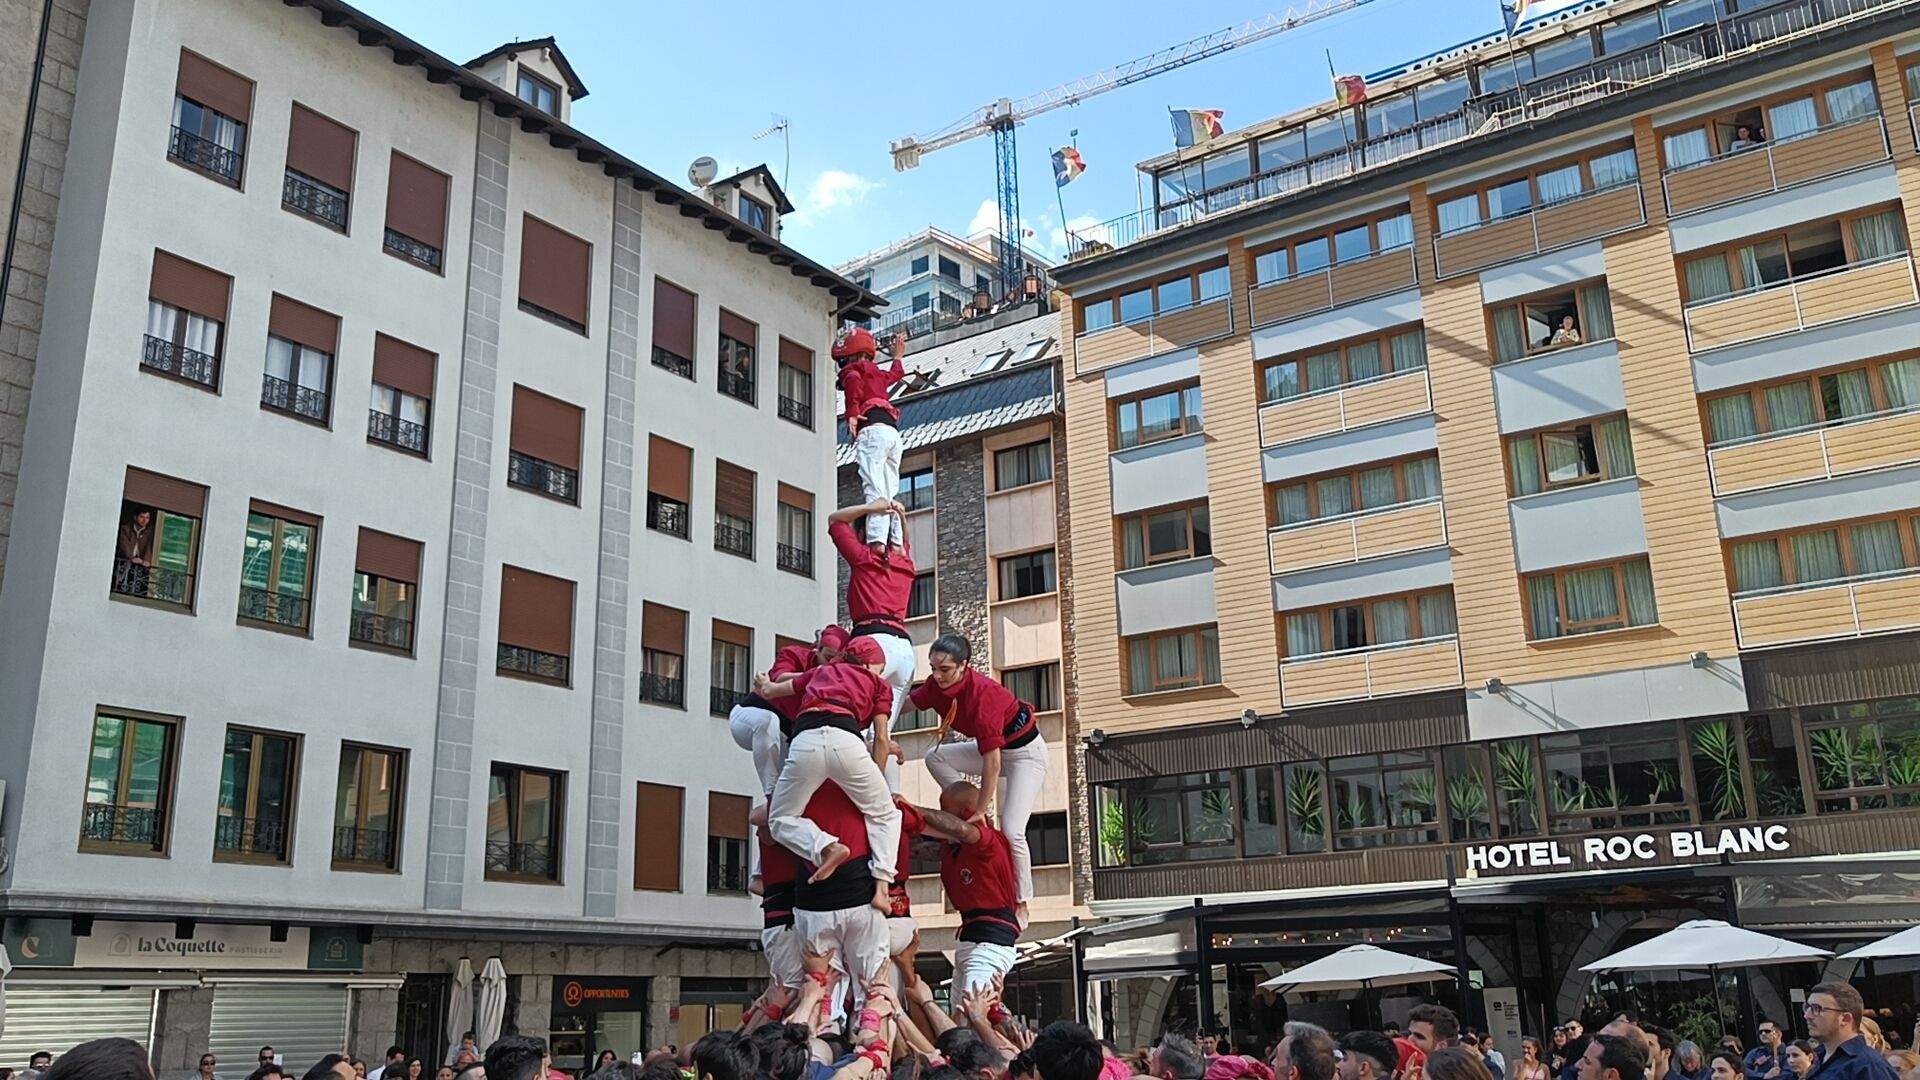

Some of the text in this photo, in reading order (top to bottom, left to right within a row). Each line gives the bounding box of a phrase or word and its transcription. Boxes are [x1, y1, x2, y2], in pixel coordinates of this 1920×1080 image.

[1466, 825, 1790, 870] HOTEL ROC BLANC
[137, 937, 225, 956] la Coquette
